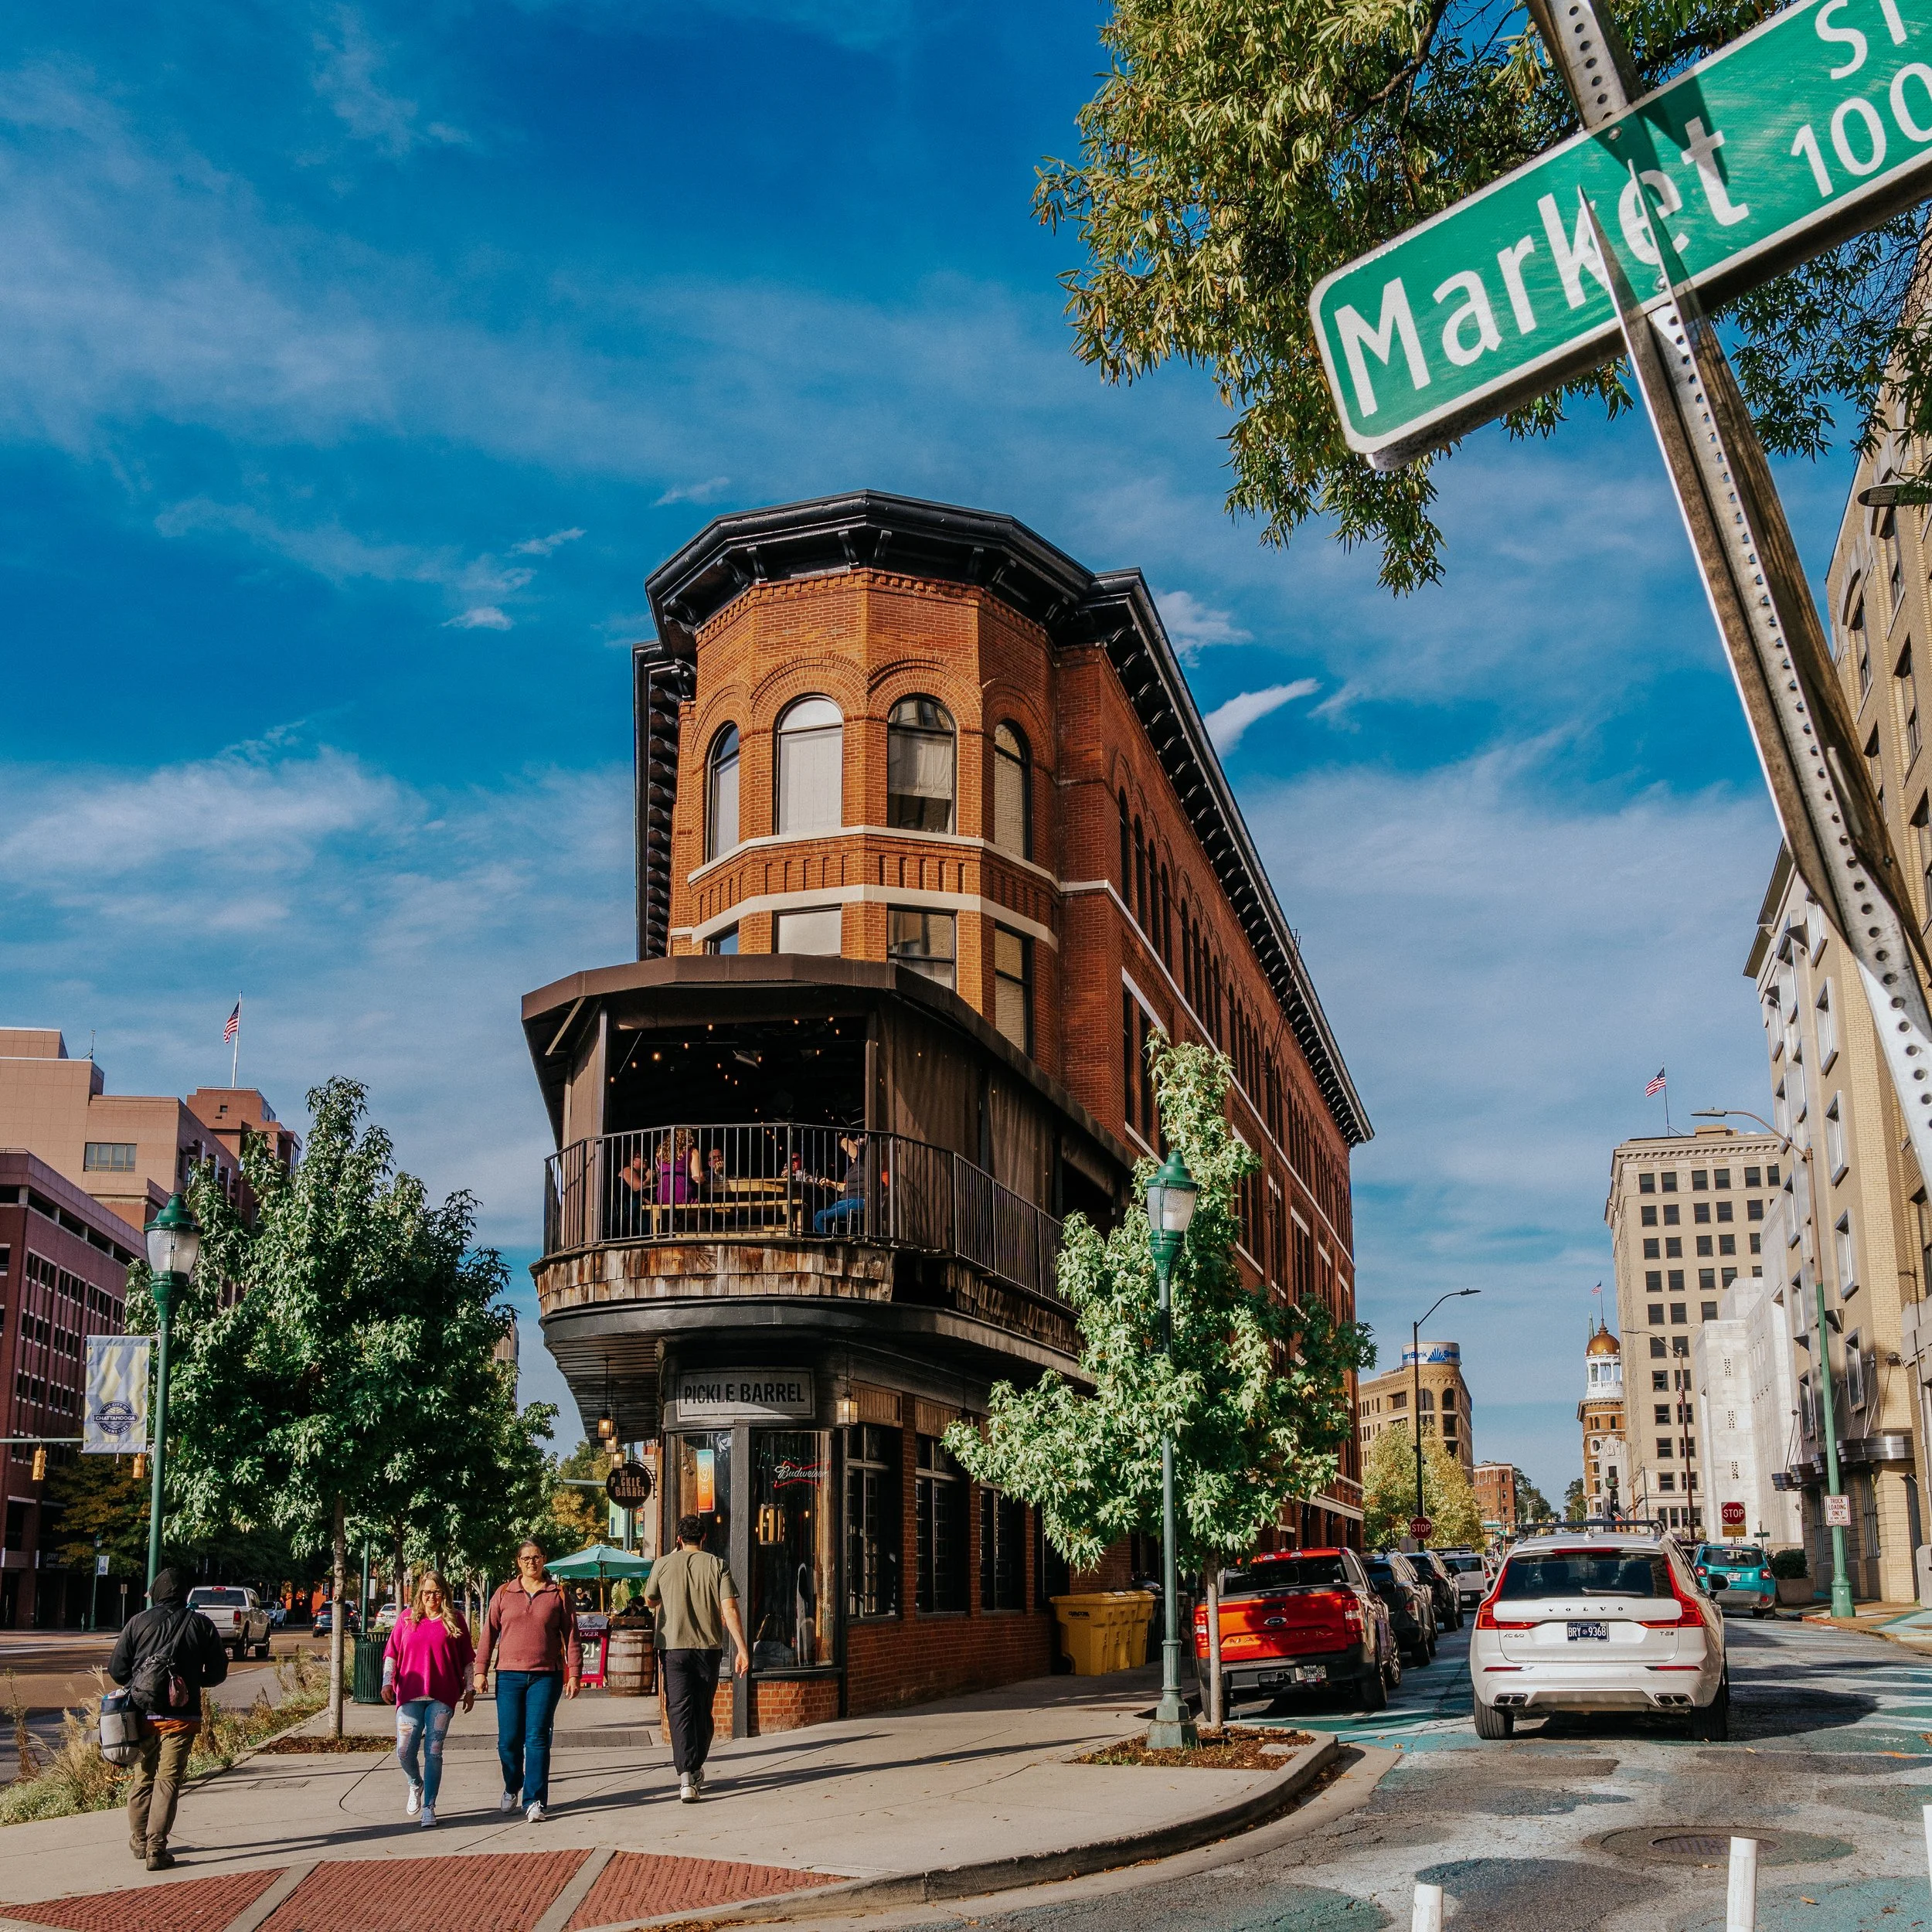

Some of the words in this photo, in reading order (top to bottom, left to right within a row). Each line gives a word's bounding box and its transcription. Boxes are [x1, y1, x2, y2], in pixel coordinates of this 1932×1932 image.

[1334, 116, 1750, 417] Market
[685, 1383, 735, 1404] PICKLE
[740, 1383, 805, 1403] BARREL
[102, 1425, 129, 1434] TENNESSEE
[774, 1465, 828, 1479] Budweiser
[611, 1477, 641, 1487] PCKLE
[615, 1486, 646, 1497] BARREL
[1723, 1509, 1744, 1518] STOP
[1411, 1524, 1431, 1532] STOP
[1568, 1627, 1581, 1637] BRY
[1588, 1627, 1607, 1637] 9368
